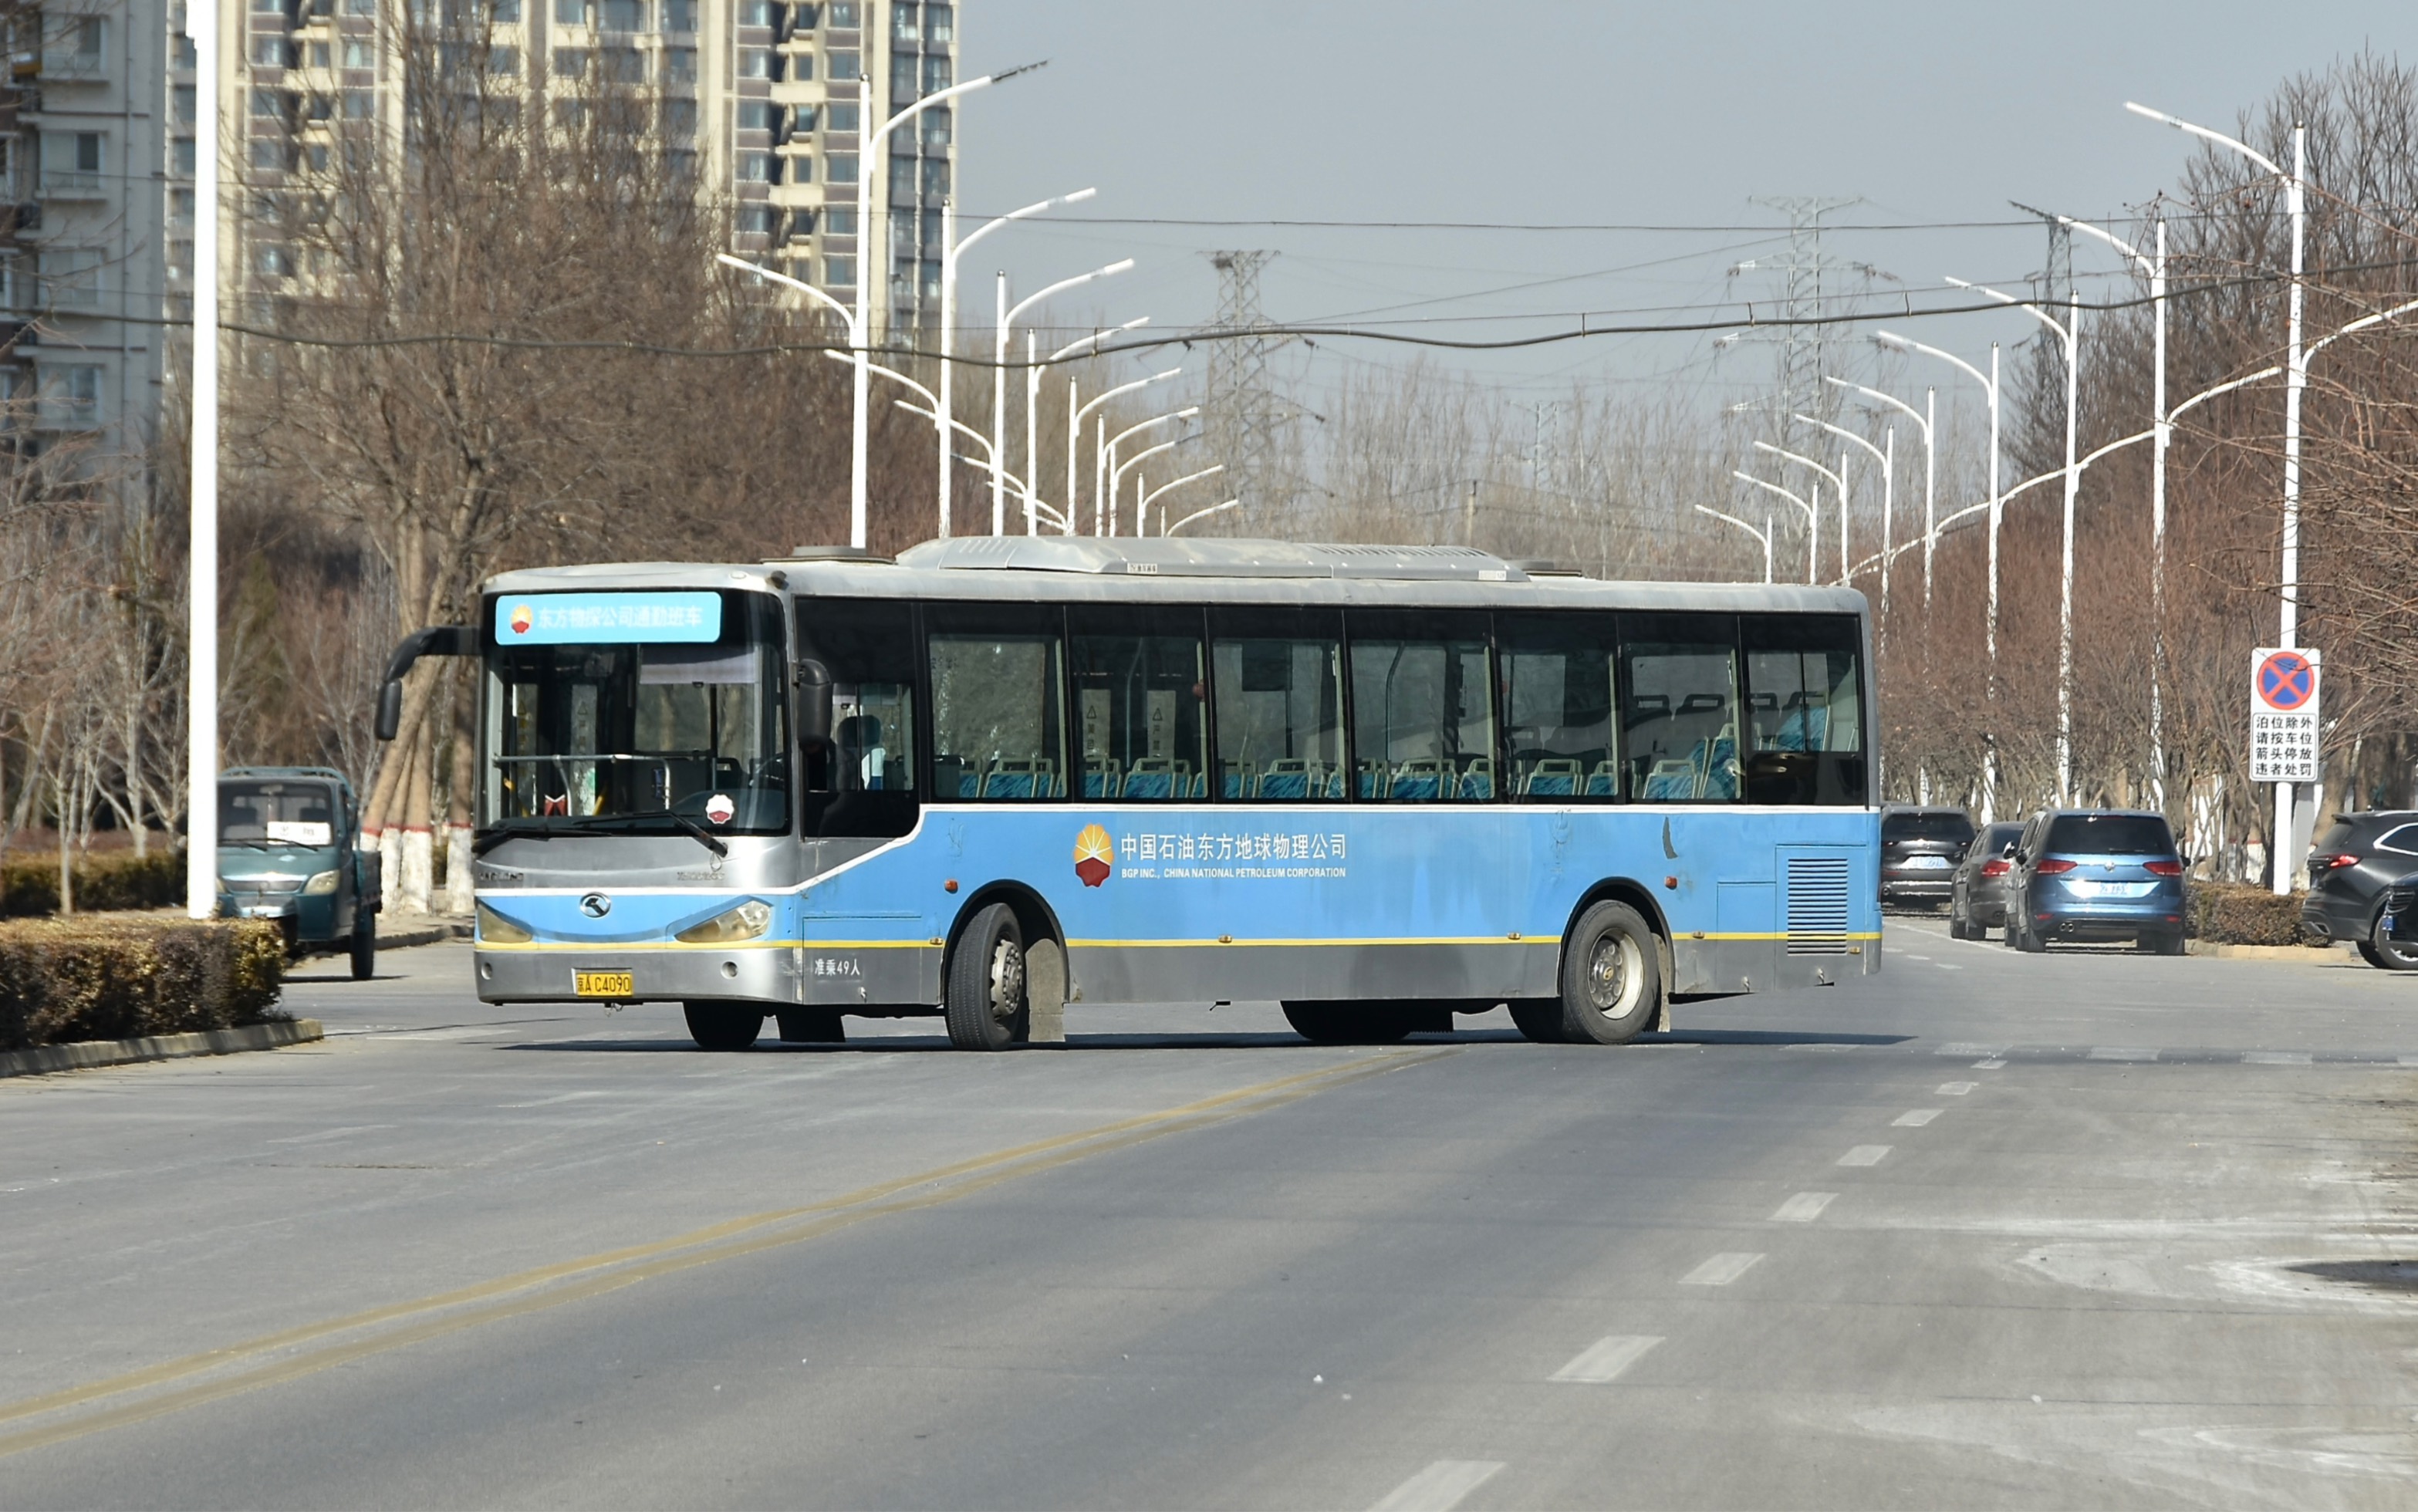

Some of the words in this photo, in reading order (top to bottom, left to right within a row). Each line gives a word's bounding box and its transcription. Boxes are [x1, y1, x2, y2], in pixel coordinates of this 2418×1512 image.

[2256, 716, 2313, 729] 泊位除外
[2256, 732, 2312, 745] 请按车位
[2256, 747, 2312, 760] 箭头停放
[2255, 762, 2312, 776] 违者处罚
[1121, 832, 1346, 861] 中国石油东方地球物理公司
[1121, 869, 1139, 879] BGP
[1163, 868, 1190, 878] CHINA
[1191, 868, 1234, 878] NATIONAL
[1235, 868, 1285, 878] PETROLEUM
[1286, 867, 1346, 877] CORPORATION
[814, 958, 860, 977] 准乘49人
